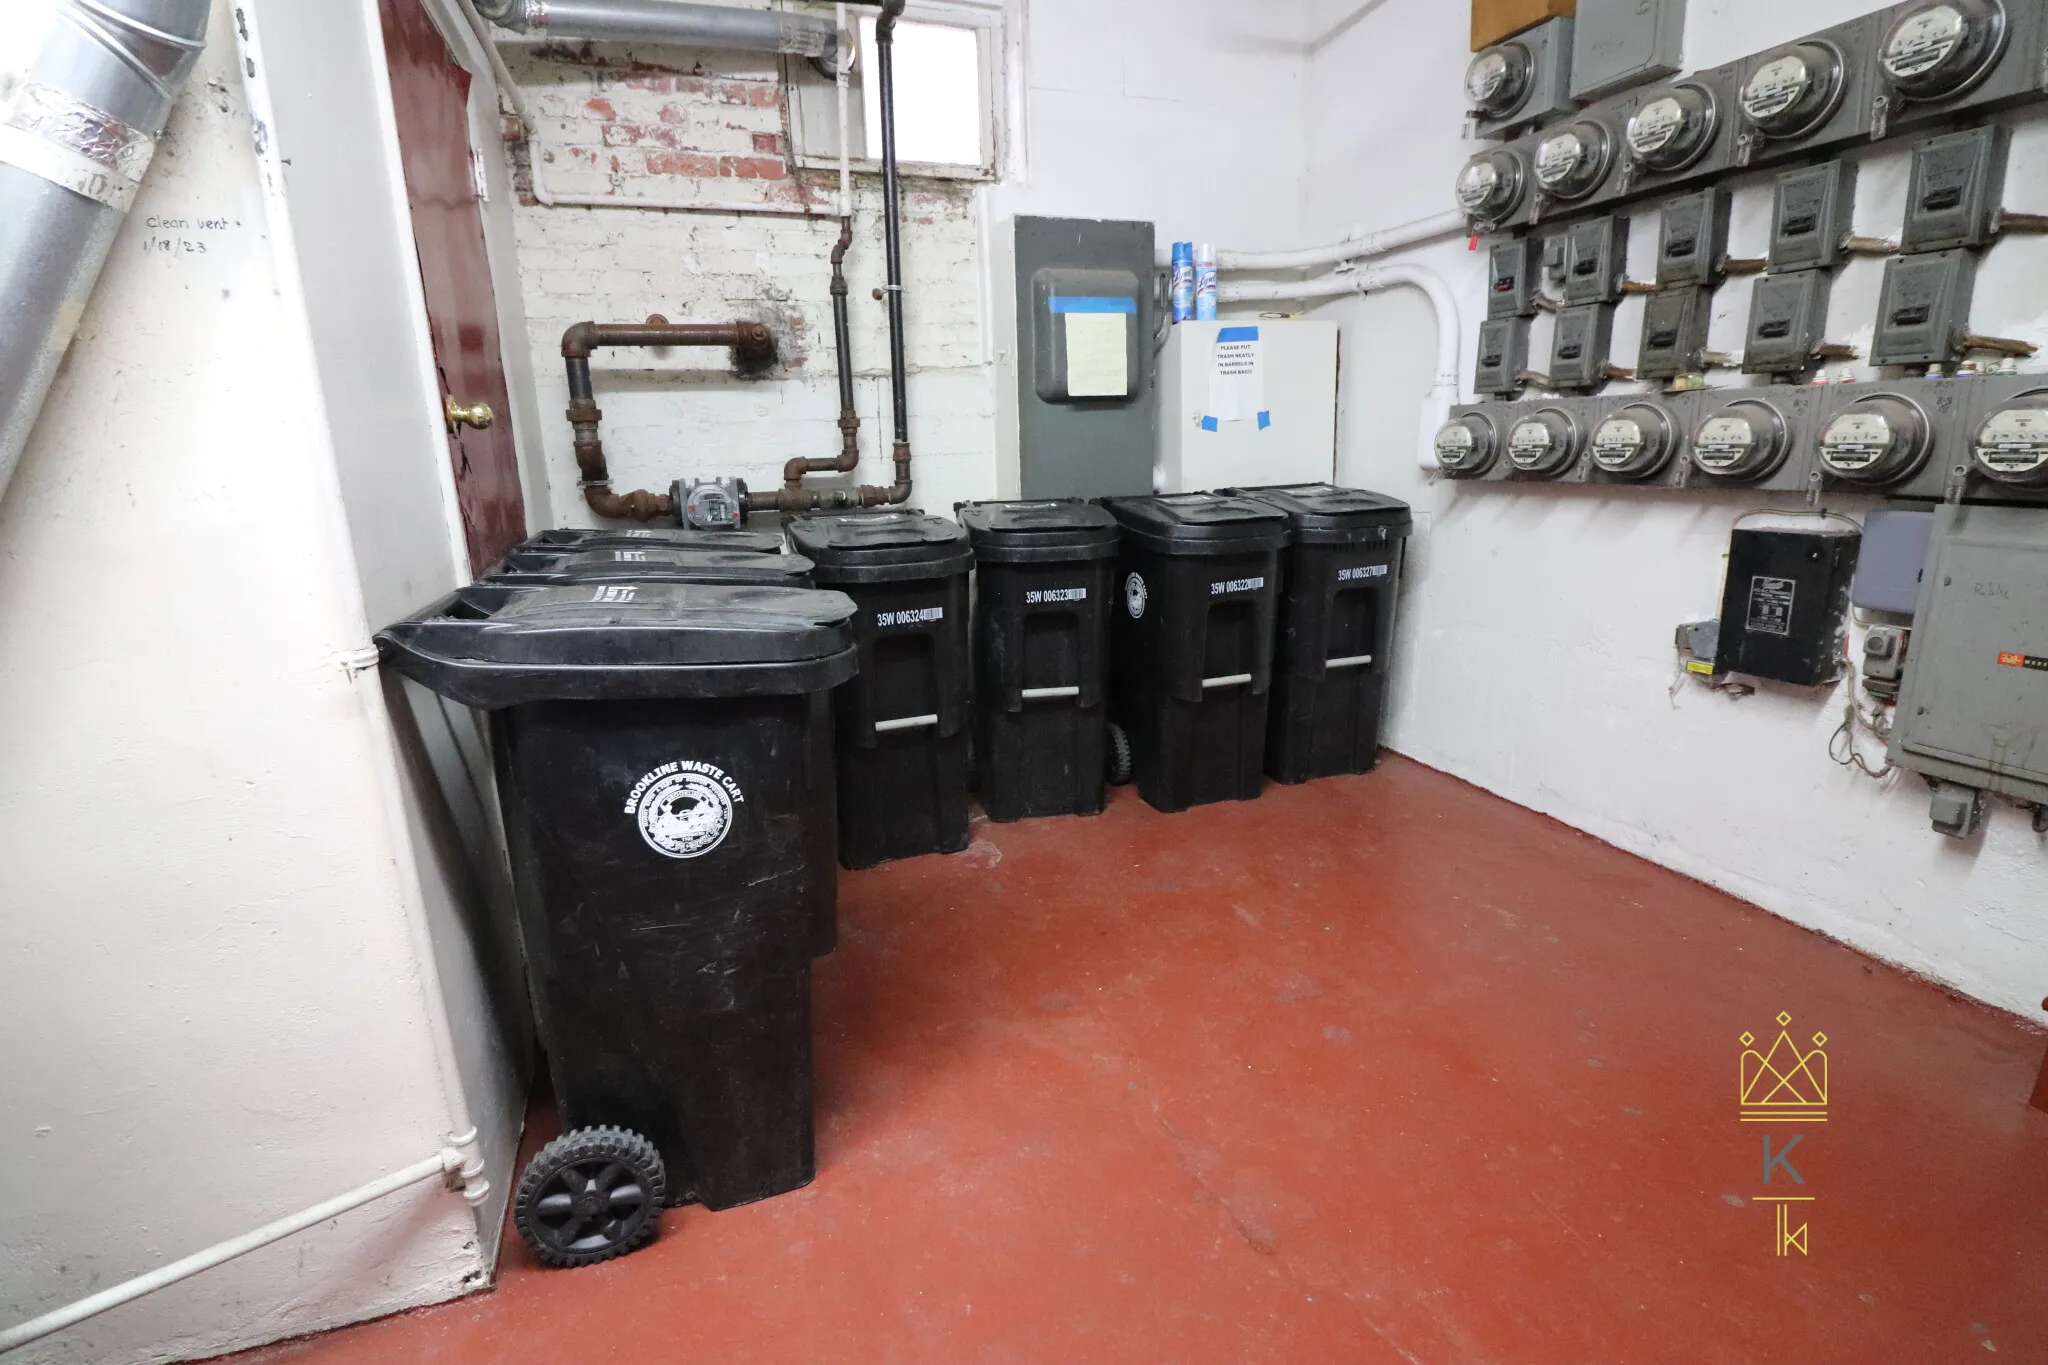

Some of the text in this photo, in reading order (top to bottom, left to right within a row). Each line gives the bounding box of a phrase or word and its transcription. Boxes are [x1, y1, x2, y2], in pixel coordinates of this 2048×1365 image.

[1338, 568, 1352, 581] 35W
[1210, 578, 1249, 595] 35W 006322
[1026, 588, 1069, 604] 35W 006323
[877, 608, 924, 627] 35W 006324
[624, 760, 744, 814] BROOKLINE WASTE CART
